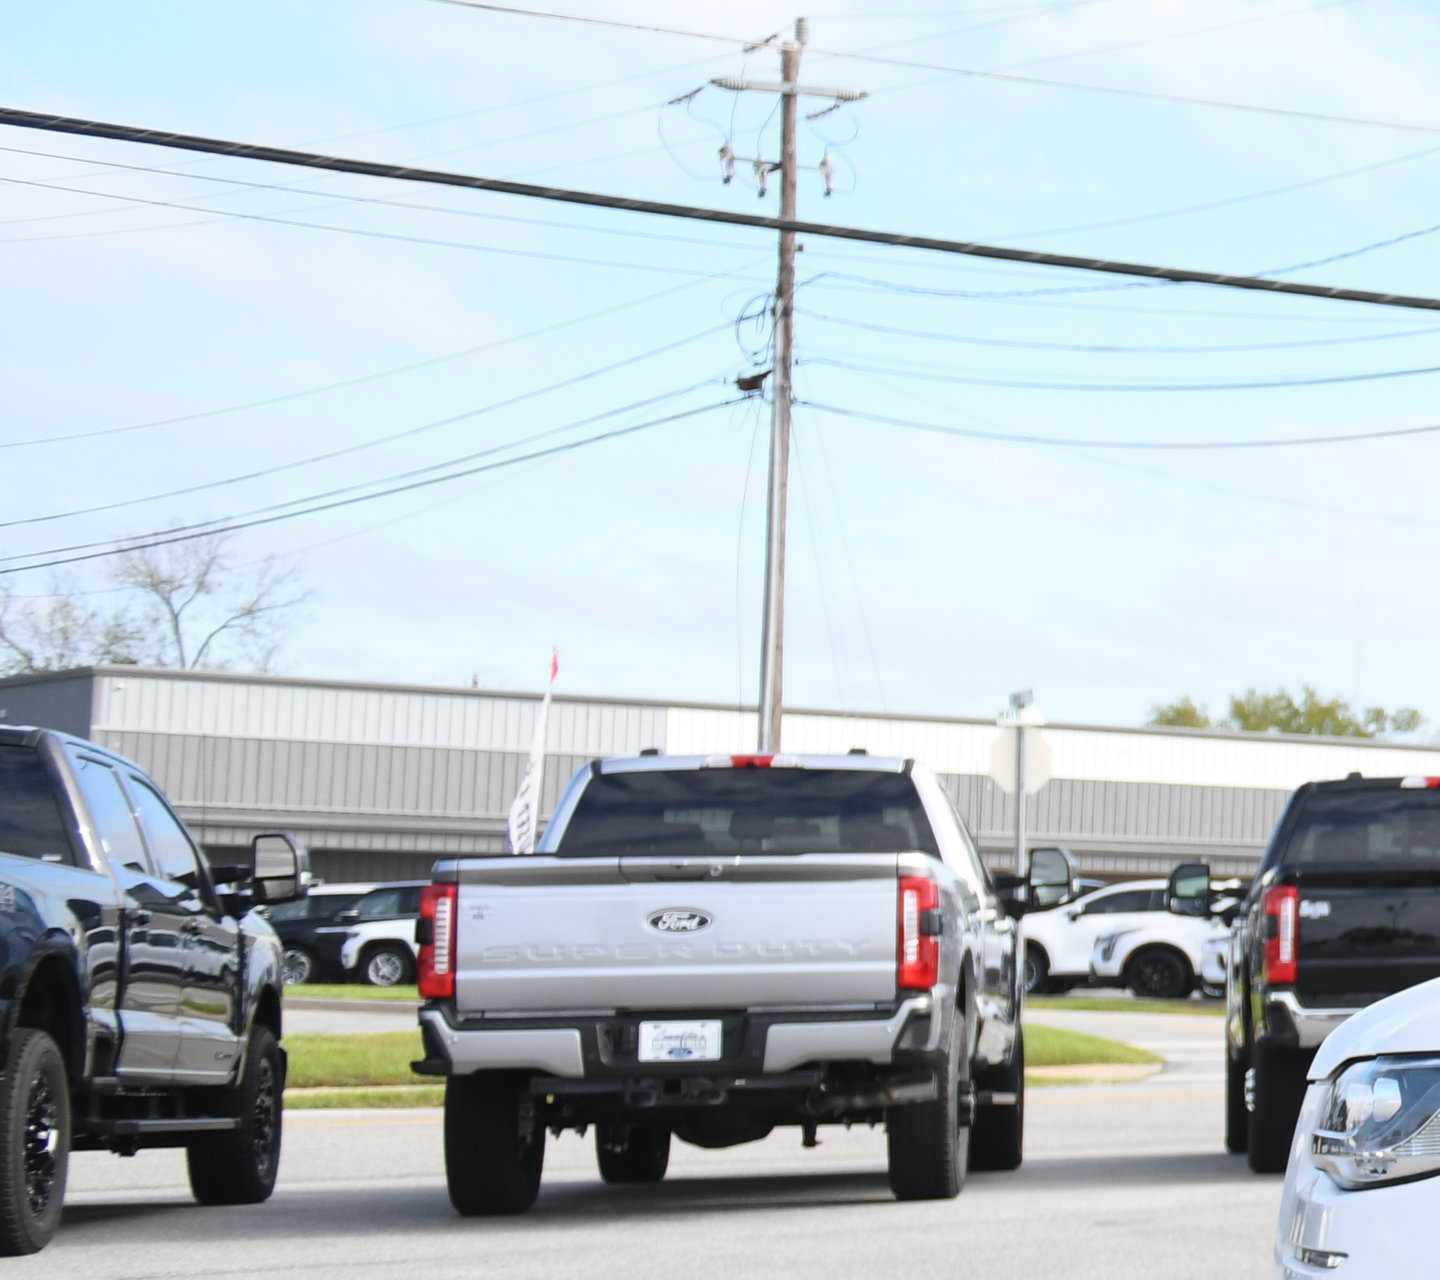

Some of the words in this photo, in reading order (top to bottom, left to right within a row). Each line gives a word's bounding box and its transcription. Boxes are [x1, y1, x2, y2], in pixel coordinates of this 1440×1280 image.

[657, 911, 700, 931] Ford
[482, 942, 693, 963] SUPER
[712, 937, 871, 957] DUTY
